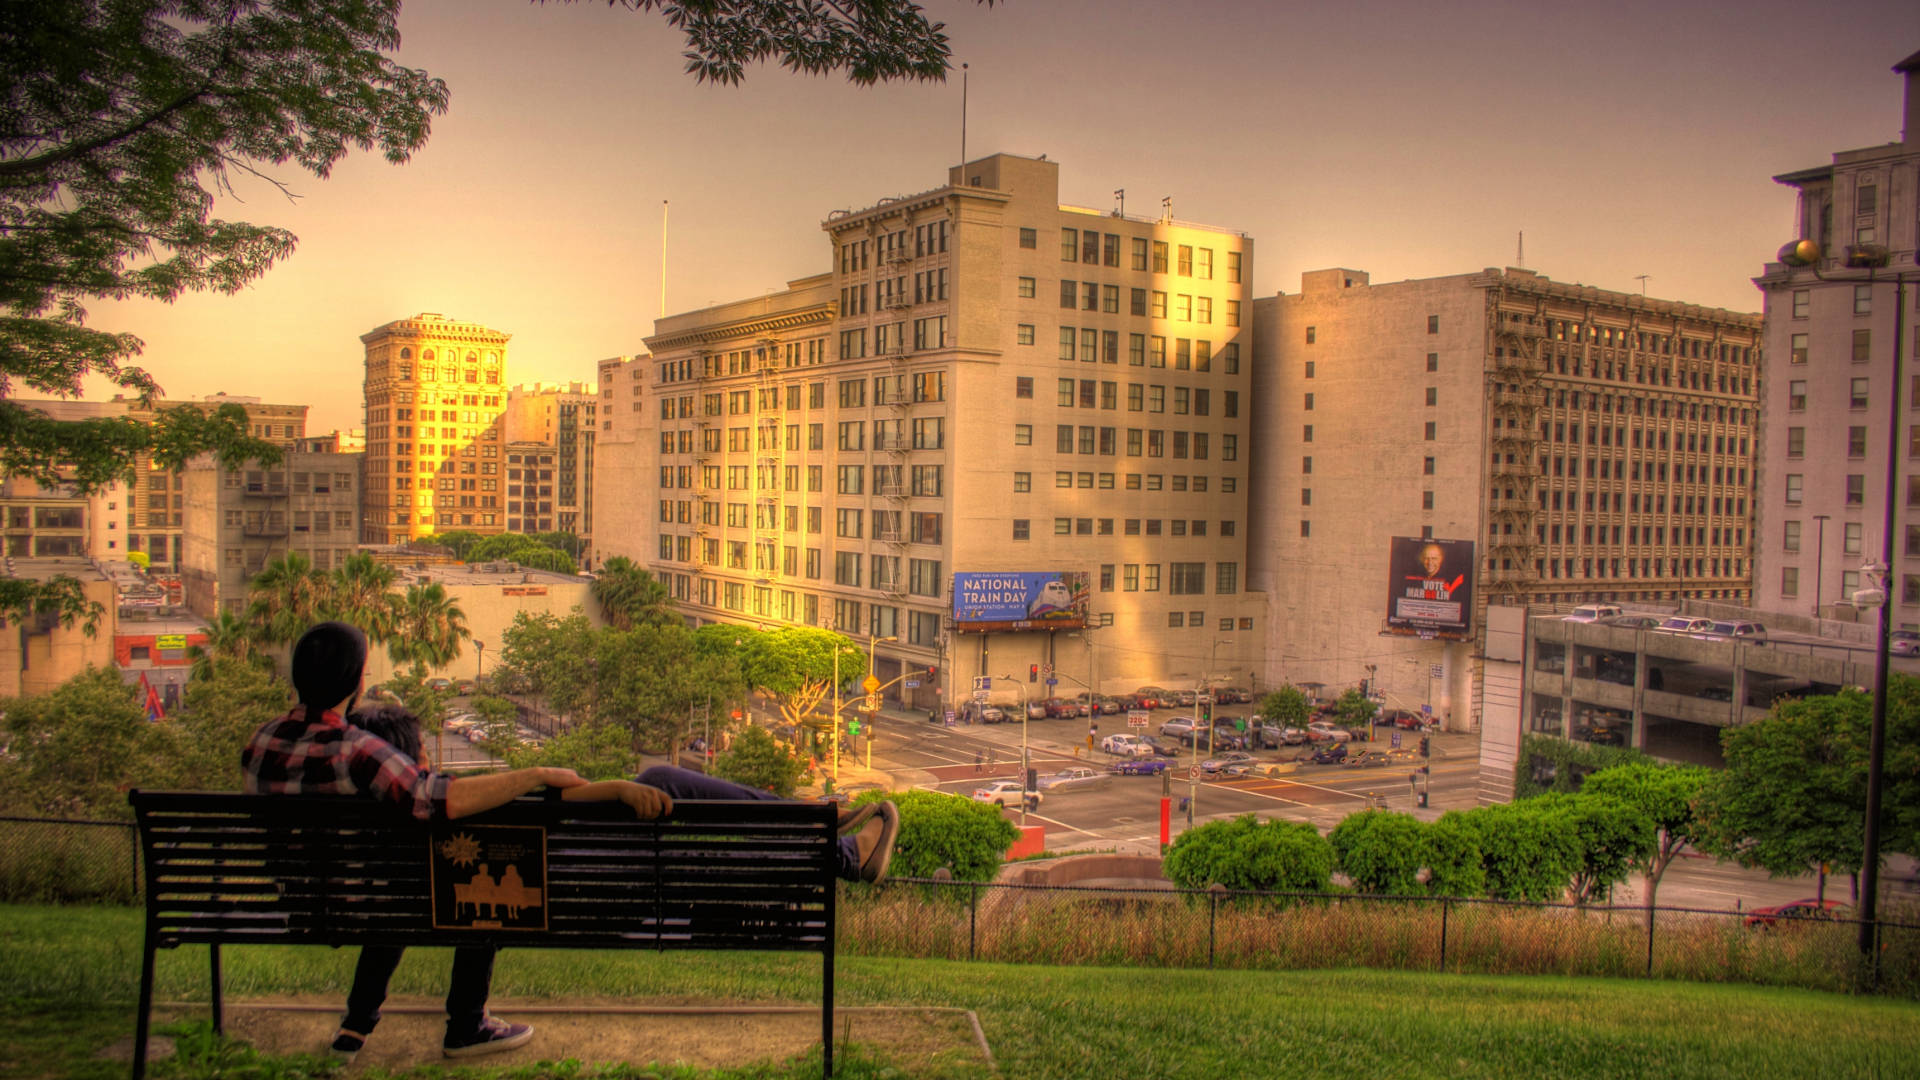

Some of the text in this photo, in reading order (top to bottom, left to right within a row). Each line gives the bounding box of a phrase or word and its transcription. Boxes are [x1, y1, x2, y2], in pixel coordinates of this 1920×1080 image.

[964, 579, 1027, 590] NATIONAL
[1423, 580, 1445, 591] VOTE
[963, 592, 1027, 603] TRAIN DAY
